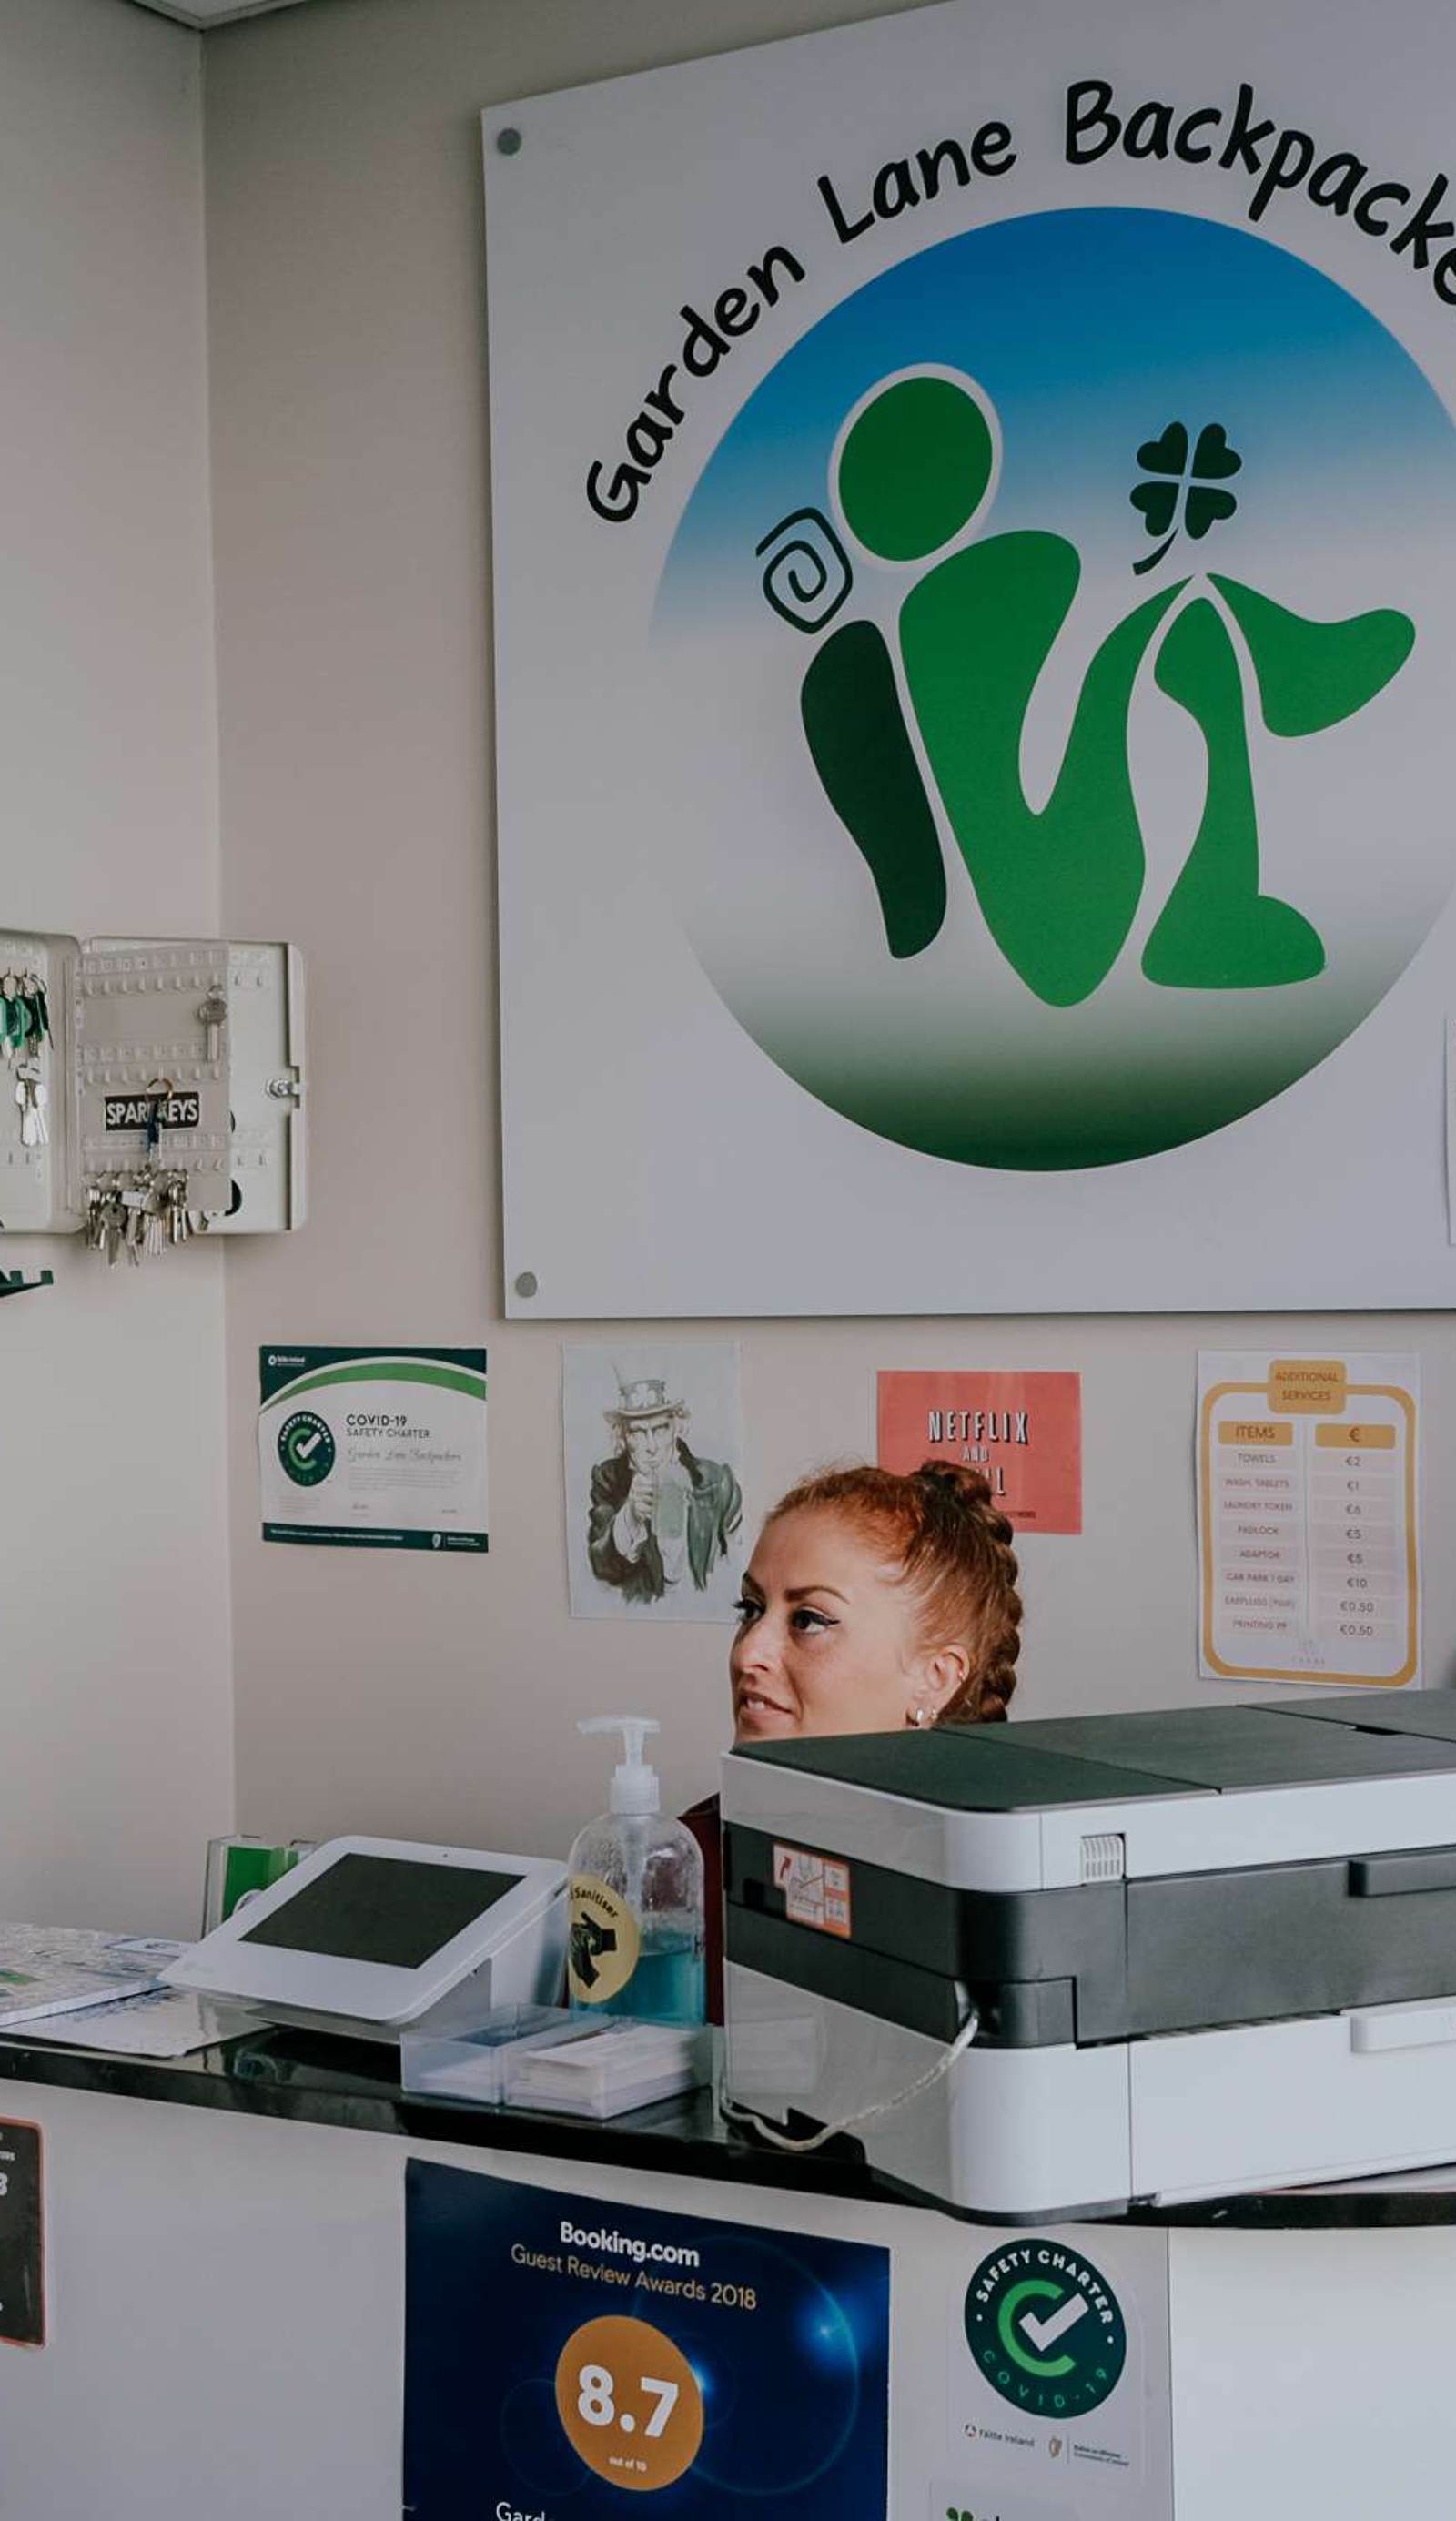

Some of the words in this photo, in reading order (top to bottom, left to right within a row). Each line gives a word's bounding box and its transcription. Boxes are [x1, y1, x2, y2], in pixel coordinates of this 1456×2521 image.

[587, 246, 805, 522] Garden
[817, 121, 1016, 243] Lane
[1275, 1372, 1339, 1382] ADDITIONAL
[1281, 1390, 1331, 1401] SERVICES
[346, 1413, 407, 1427] COVID-19
[280, 1416, 301, 1442] SAFETY
[347, 1427, 383, 1437] SAFETY
[386, 1428, 430, 1439] CHARTER
[928, 1411, 1029, 1445] NETFLIX
[1235, 1426, 1276, 1440] ITEMS
[1348, 1426, 1360, 1443] €
[962, 1445, 990, 1463] AND
[1238, 1453, 1277, 1464] TOWELS
[1346, 1455, 1362, 1467] €2
[1238, 1525, 1279, 1535] PADLOCK
[1240, 1549, 1280, 1559] ADAPTOR
[1346, 1577, 1368, 1588] €10
[1340, 1601, 1375, 1613] €0.50
[1340, 1624, 1373, 1636] €0.50
[574, 1885, 619, 1918] Sanitiser
[560, 2221, 700, 2268] Booking.com
[511, 2243, 563, 2273] Guest
[568, 2255, 631, 2287] Review
[636, 2271, 706, 2302] Awards
[711, 2283, 757, 2310] 2018
[976, 2249, 1031, 2303] SAFETY
[1038, 2249, 1114, 2324] CHARTER
[983, 2349, 1107, 2408] COVID-19
[577, 2364, 680, 2439] 8.7
[625, 2458, 635, 2469] of
